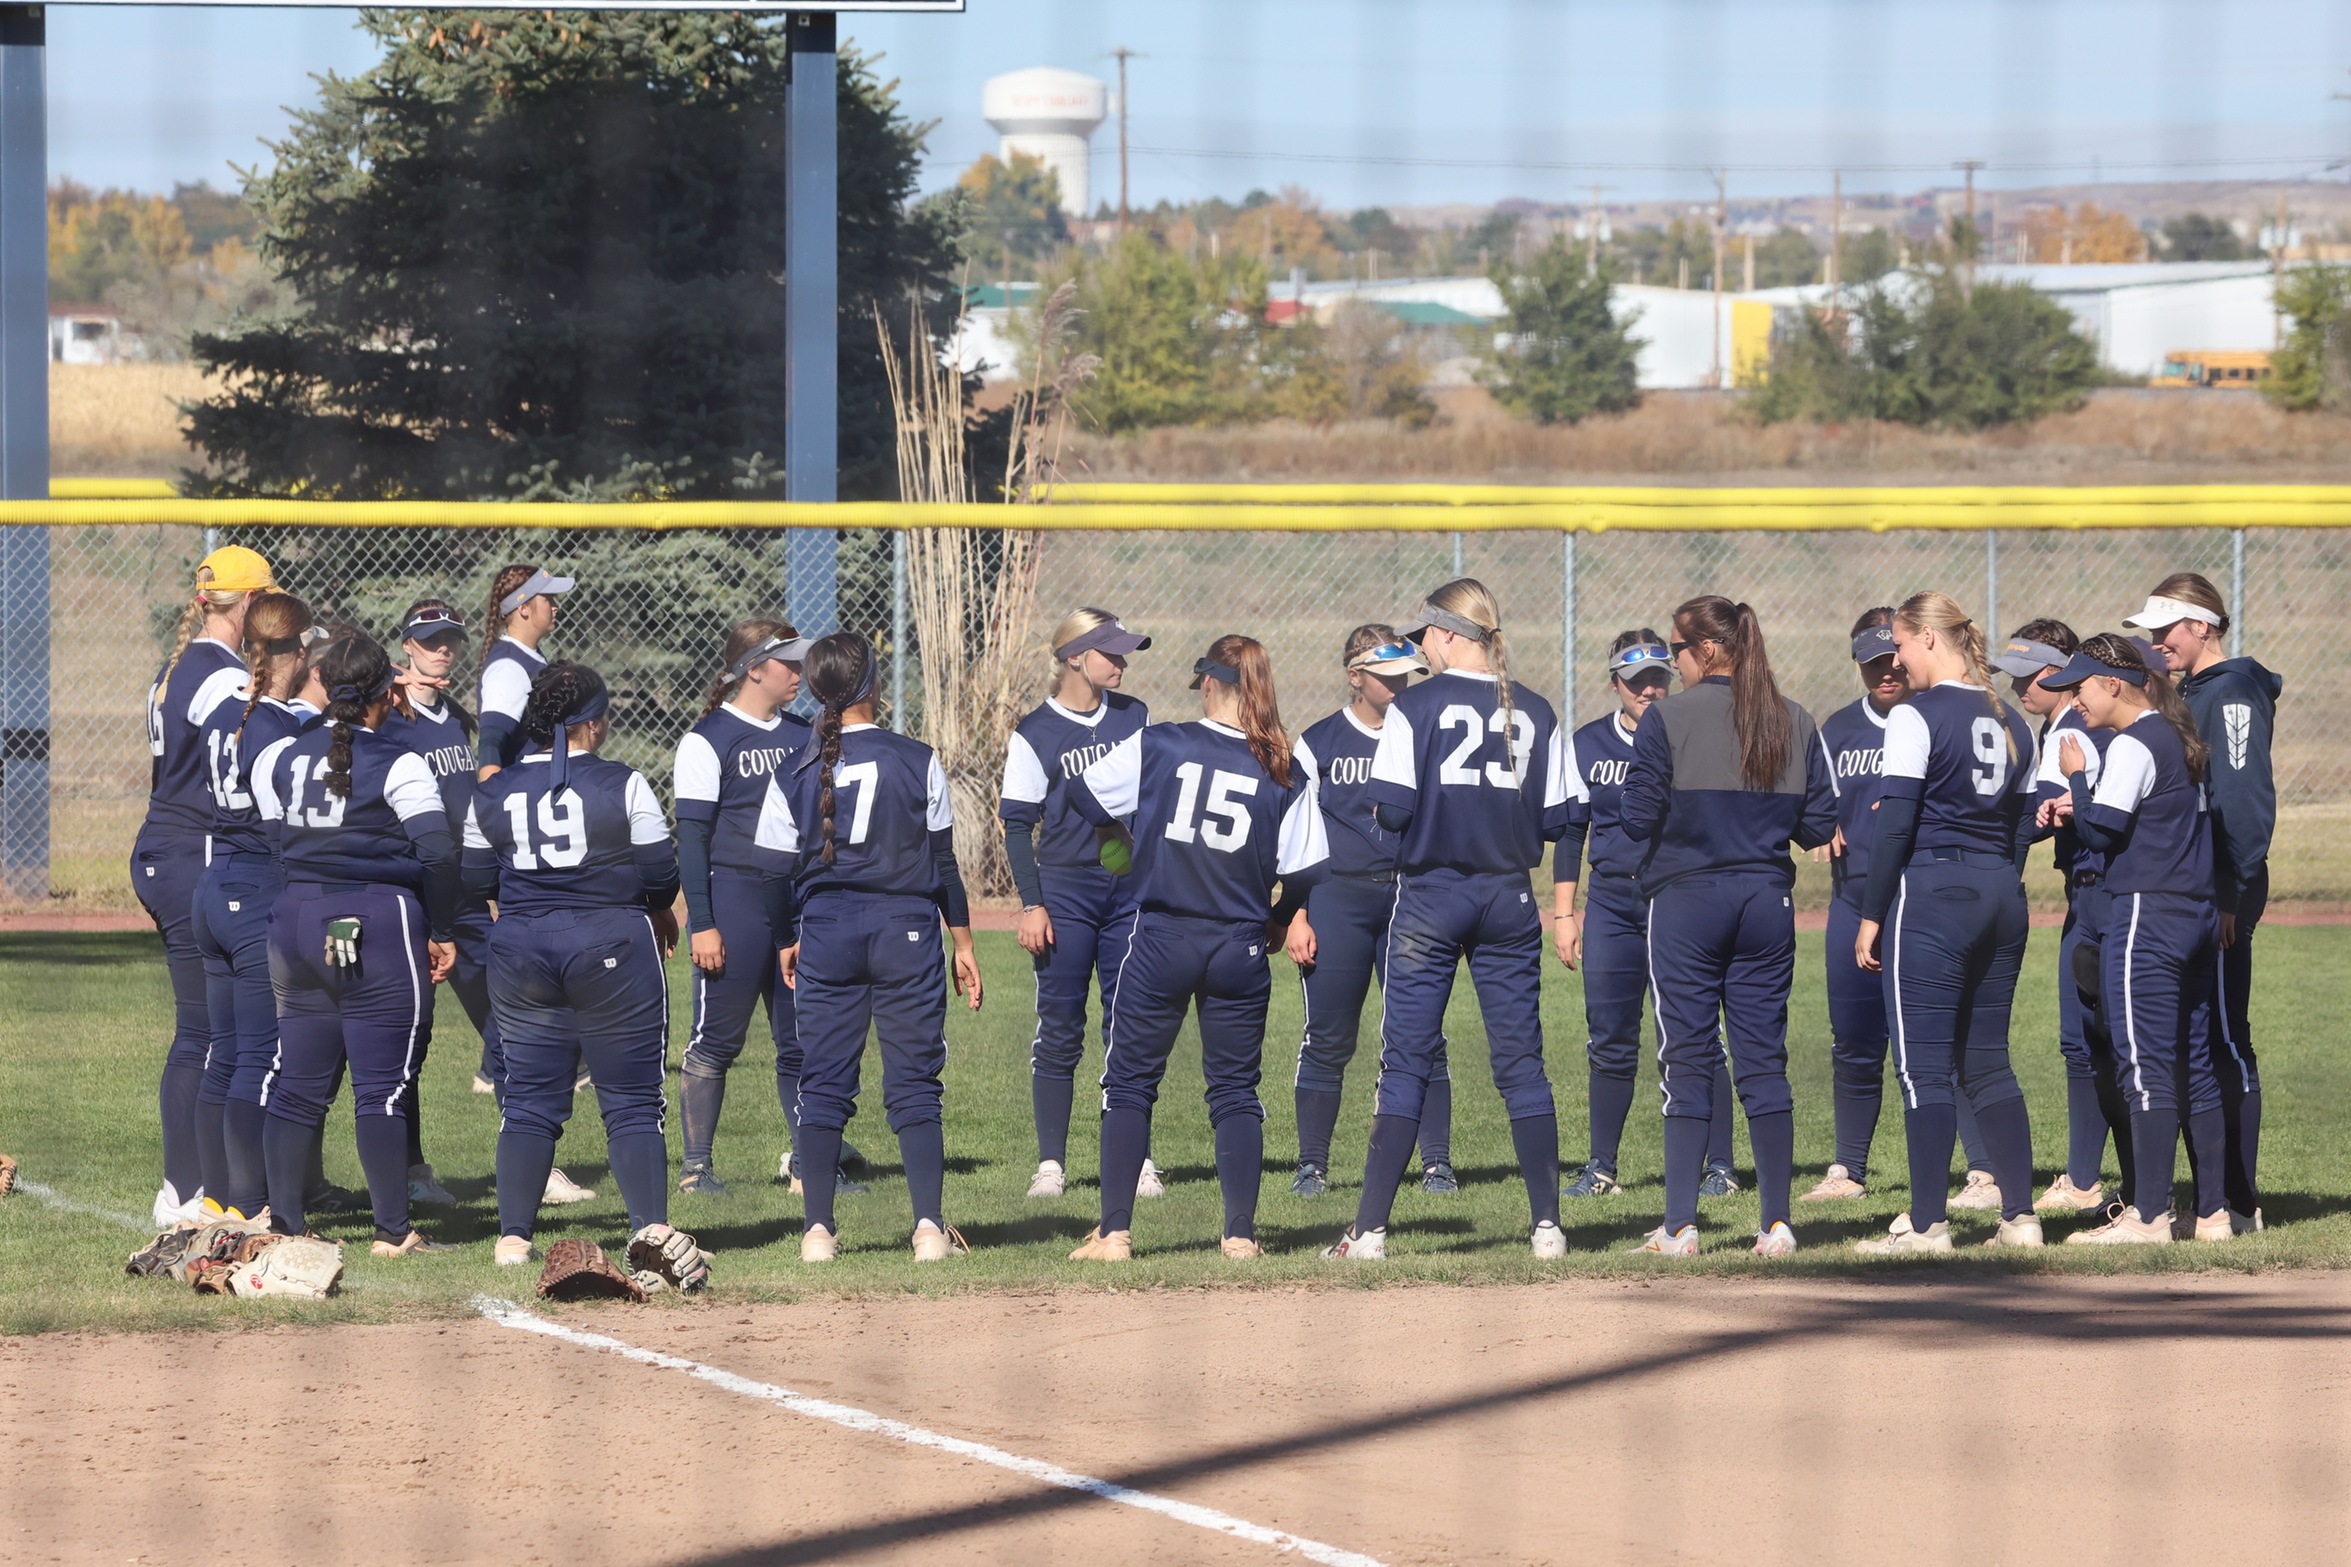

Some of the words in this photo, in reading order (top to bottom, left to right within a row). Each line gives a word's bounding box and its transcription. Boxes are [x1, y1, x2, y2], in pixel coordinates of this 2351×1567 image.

[207, 729, 253, 810] 12
[1330, 757, 1372, 785] COU
[1439, 704, 1535, 789] 23
[1590, 759, 1630, 785] COU
[1971, 716, 2007, 796] 9
[286, 755, 350, 828] 13
[503, 787, 588, 870] 19
[835, 761, 878, 845] 7
[1164, 761, 1259, 853] 15
